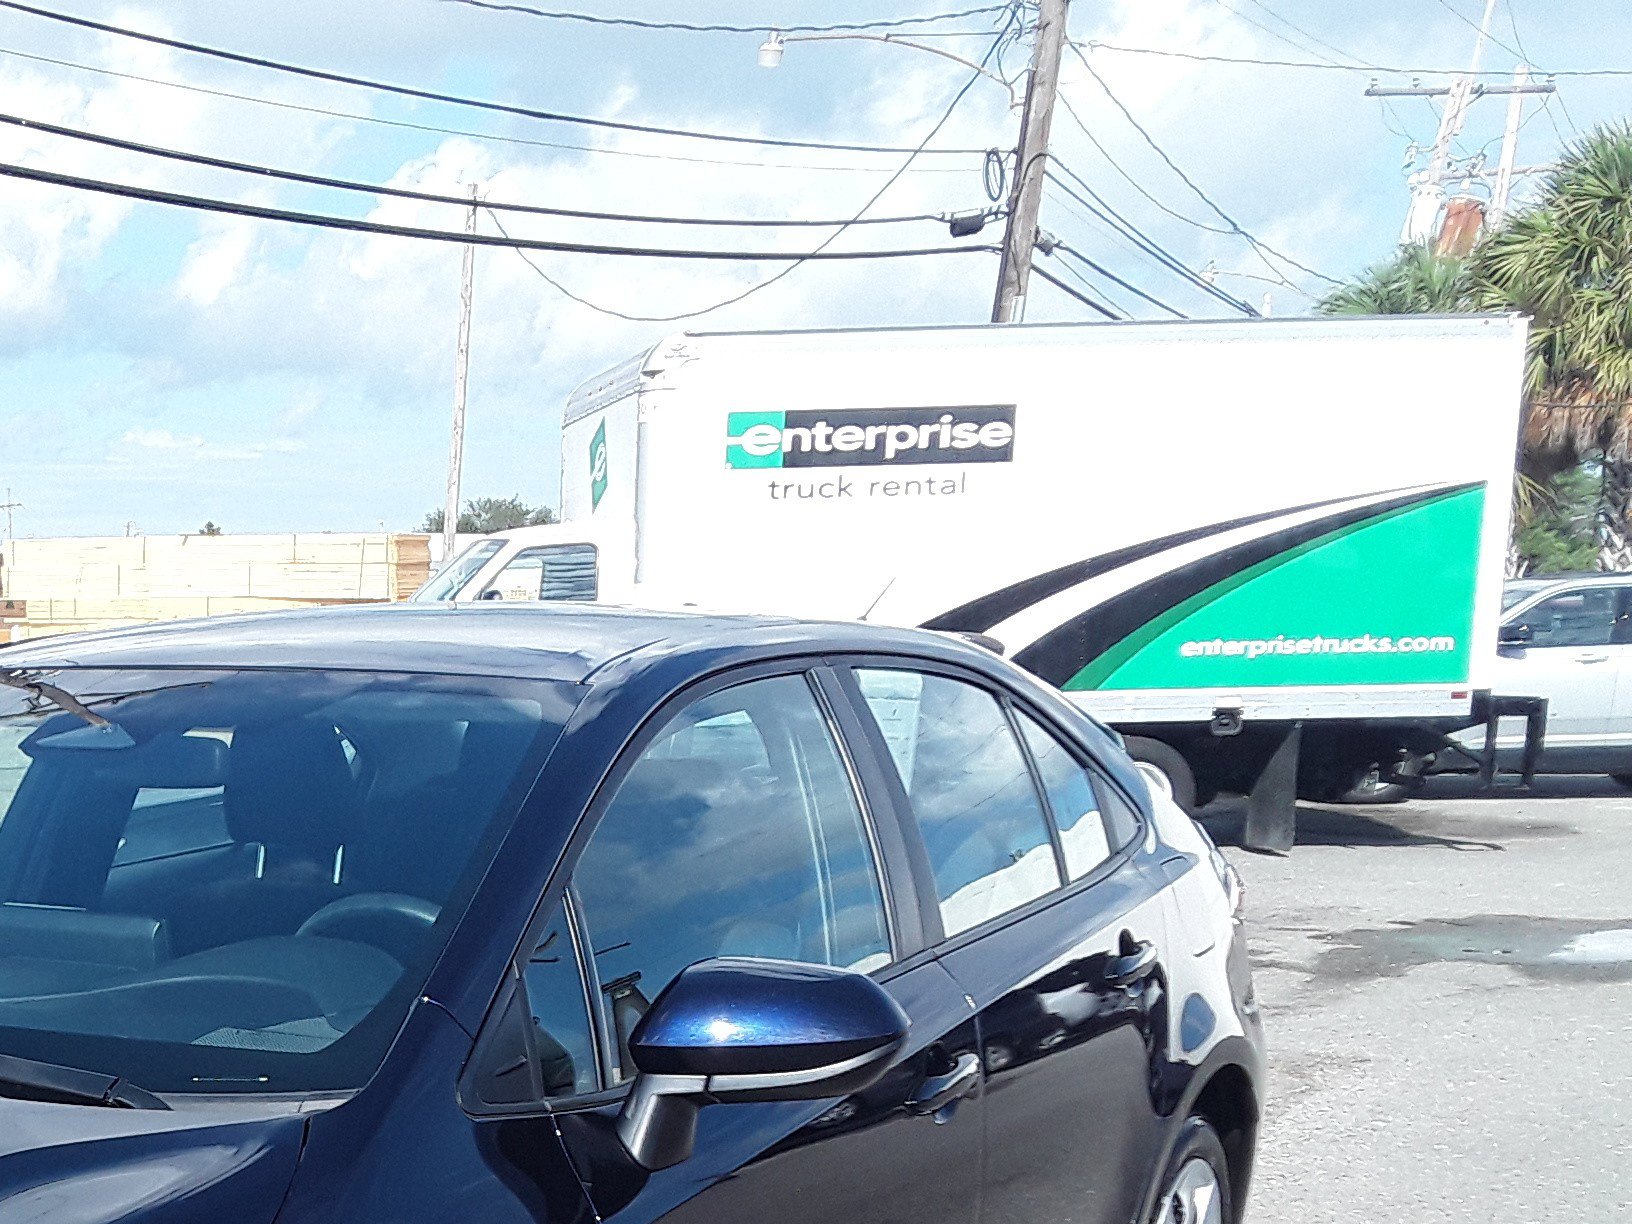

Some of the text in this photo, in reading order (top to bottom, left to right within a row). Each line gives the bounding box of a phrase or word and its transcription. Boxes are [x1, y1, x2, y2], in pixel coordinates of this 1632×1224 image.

[740, 413, 1014, 461] enterprise
[768, 471, 967, 500] truck rental
[1179, 633, 1456, 659] enterprisetrucks.com
